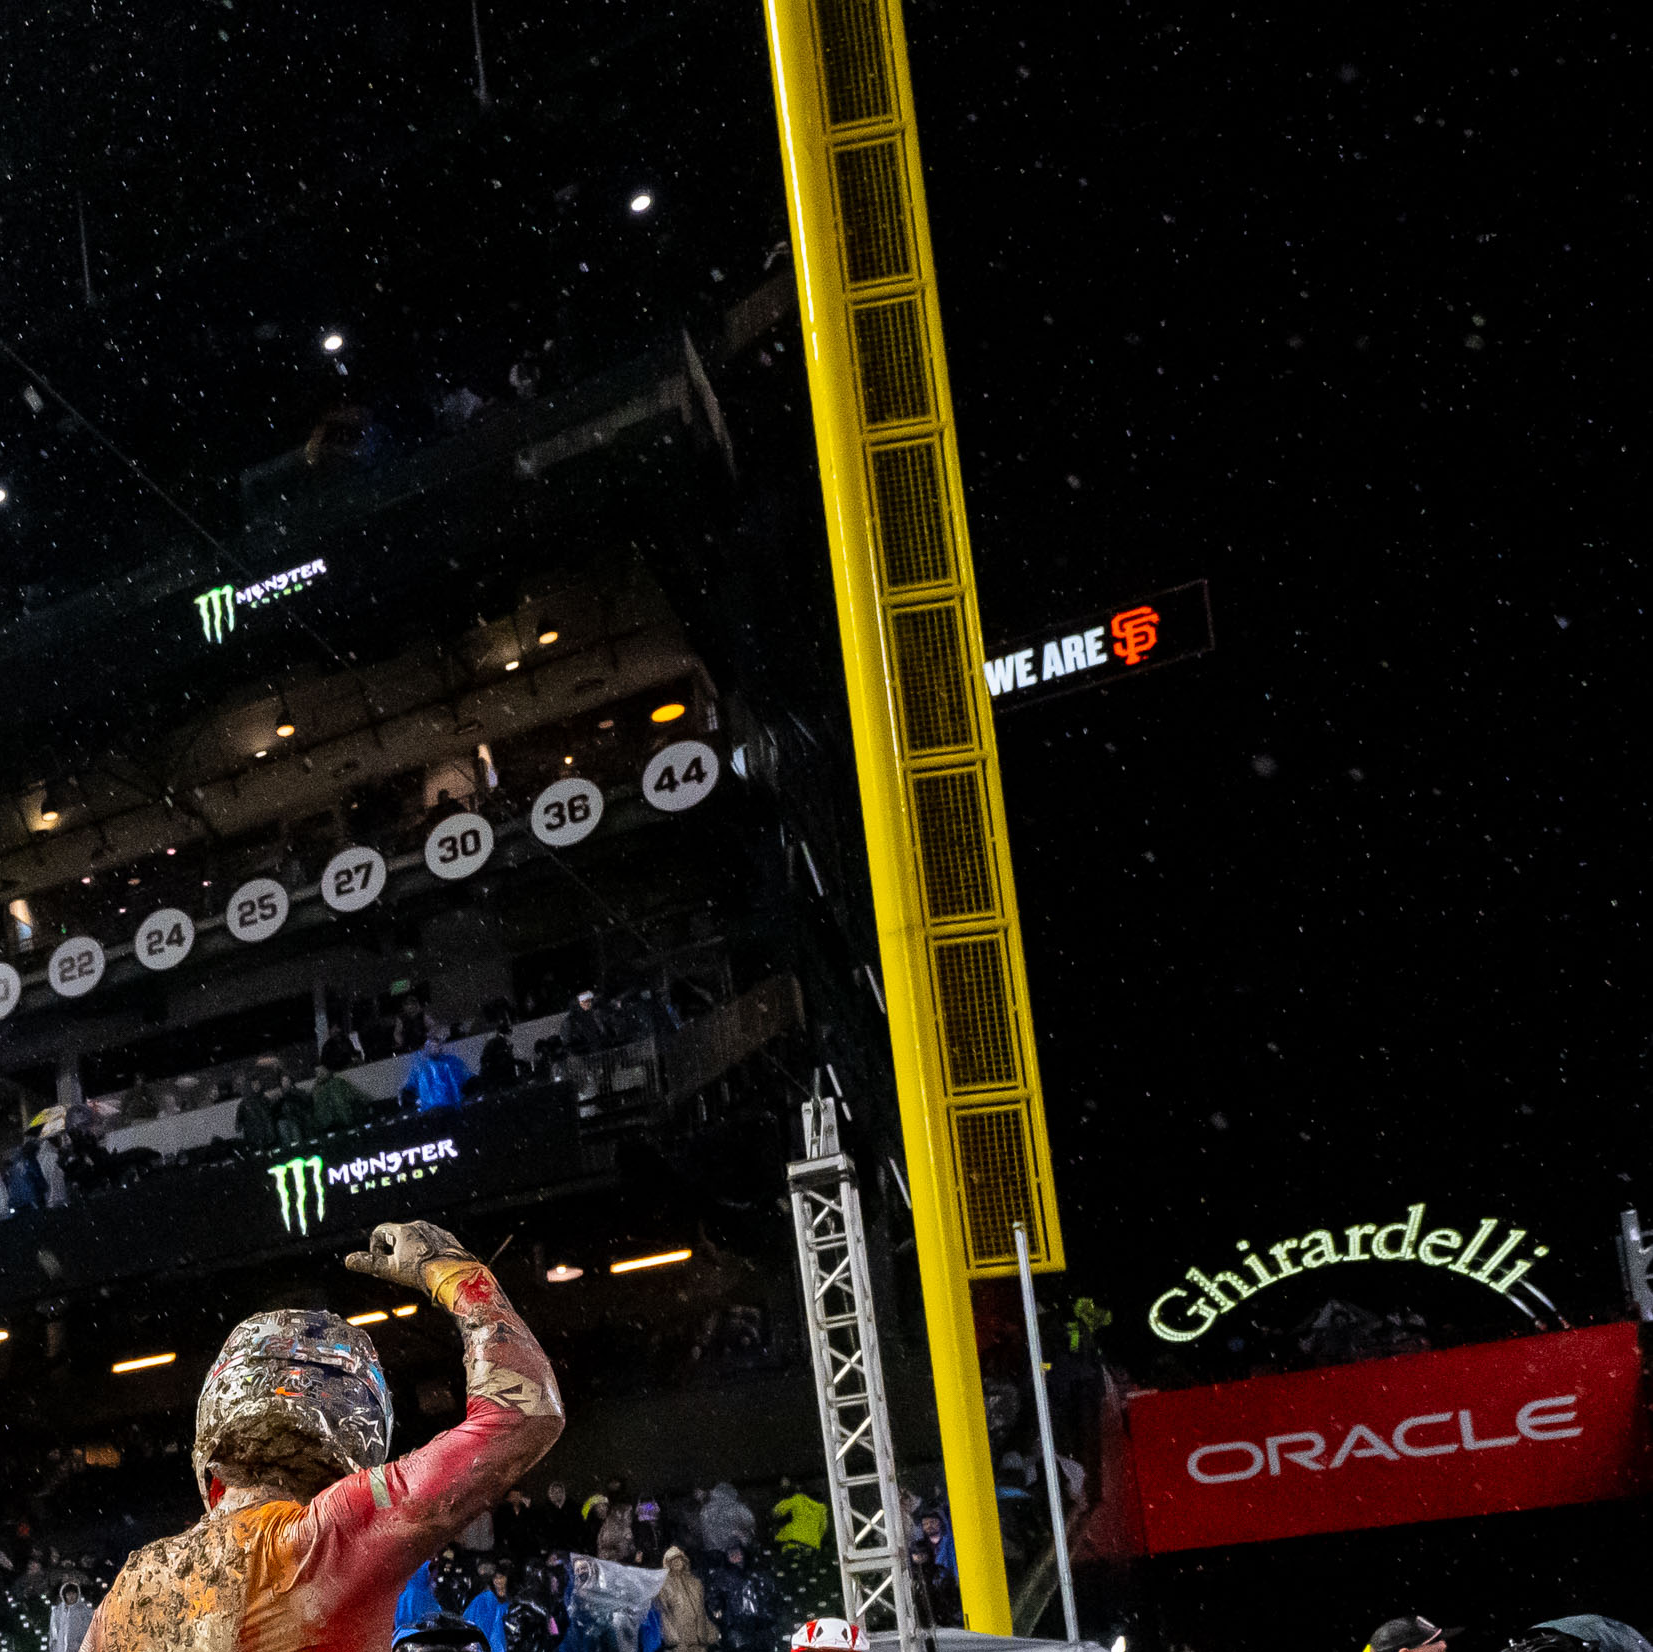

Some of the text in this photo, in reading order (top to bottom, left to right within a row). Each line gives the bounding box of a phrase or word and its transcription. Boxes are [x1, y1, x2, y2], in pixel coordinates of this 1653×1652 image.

[983, 648, 1037, 696] WE
[1042, 626, 1108, 682] ARE
[654, 755, 708, 794] 44
[544, 794, 591, 831] 36
[437, 829, 482, 864] 30
[333, 860, 375, 897] 27
[237, 892, 278, 929] 25
[146, 923, 186, 956] 24
[58, 950, 94, 985] 22
[327, 1138, 459, 1185] MONSTER
[350, 1165, 438, 1194] ENERGY
[1148, 1203, 1550, 1342] Ghirardelli
[1187, 1395, 1584, 1484] ORACLE
